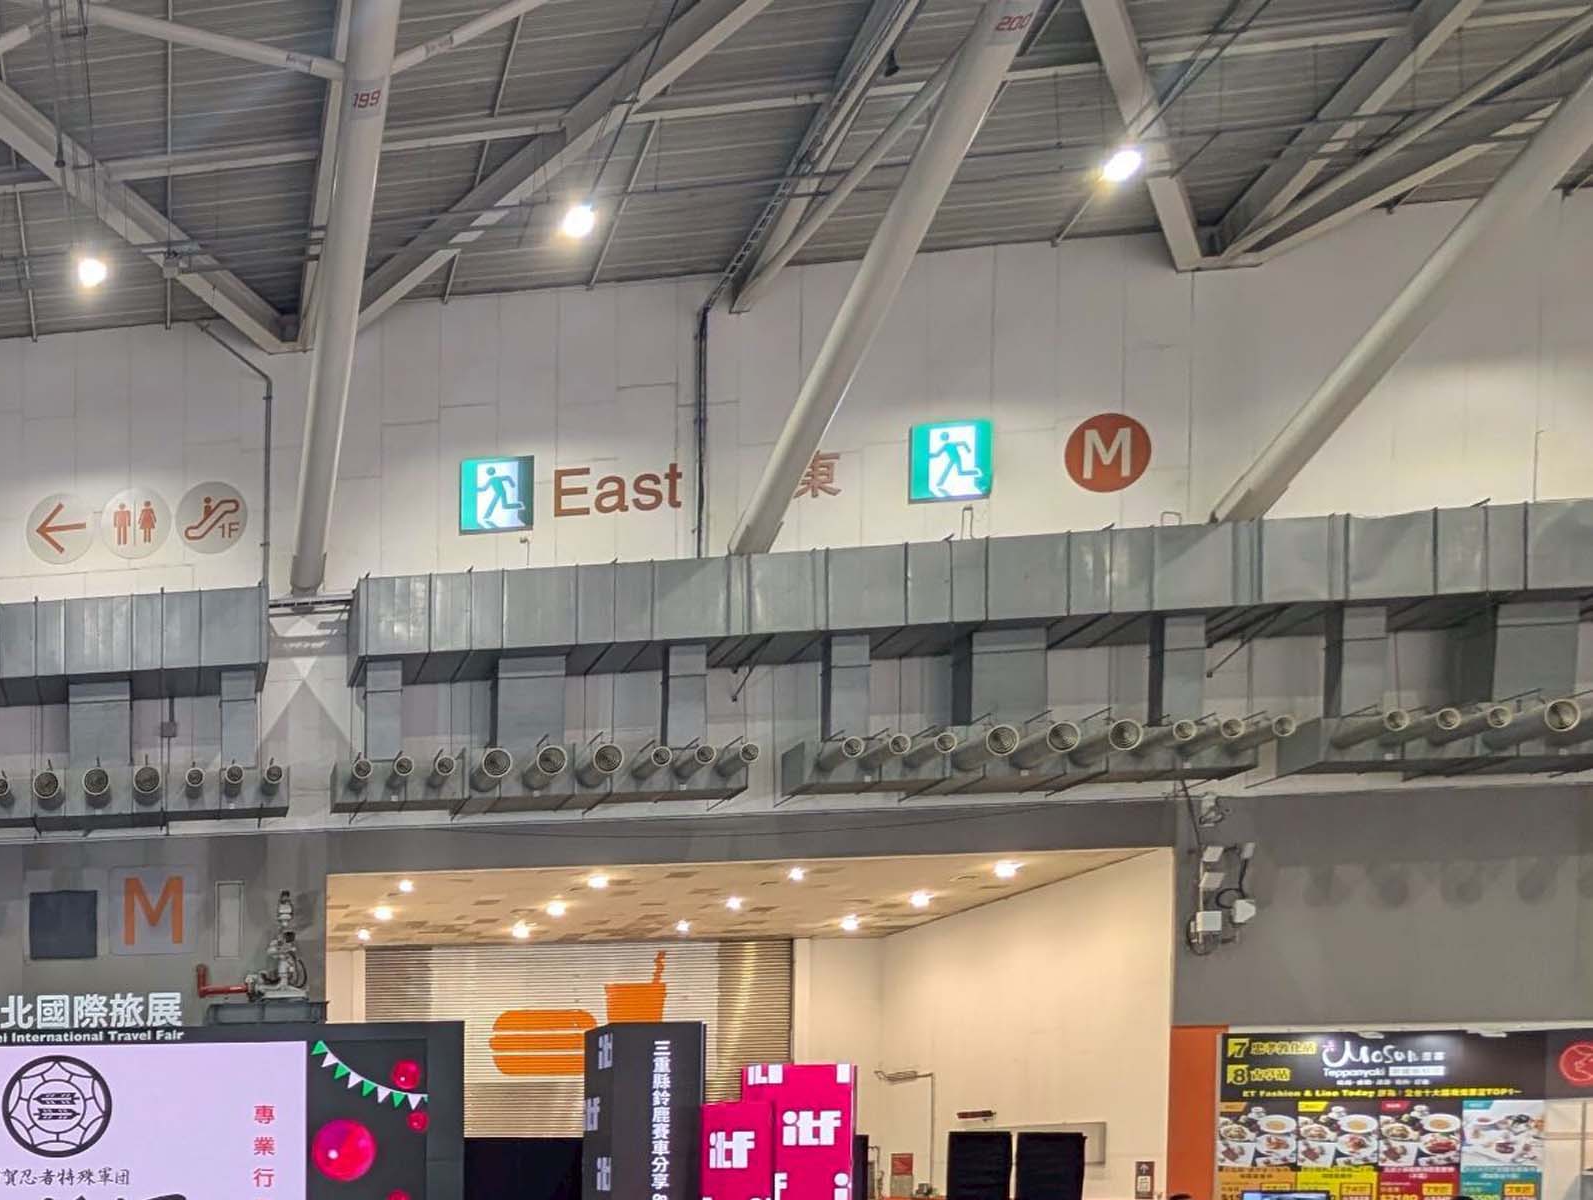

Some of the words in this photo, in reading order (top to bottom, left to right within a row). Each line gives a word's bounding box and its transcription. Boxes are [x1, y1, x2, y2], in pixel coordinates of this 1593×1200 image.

[1083, 428, 1131, 479] M
[553, 462, 682, 517] East
[217, 521, 240, 539] 1F
[123, 876, 183, 945] M
[11, 1031, 103, 1043] International
[108, 1030, 152, 1041] Travel
[156, 1030, 184, 1041] Fair
[783, 1110, 841, 1146] itf
[709, 1131, 754, 1169] itf
